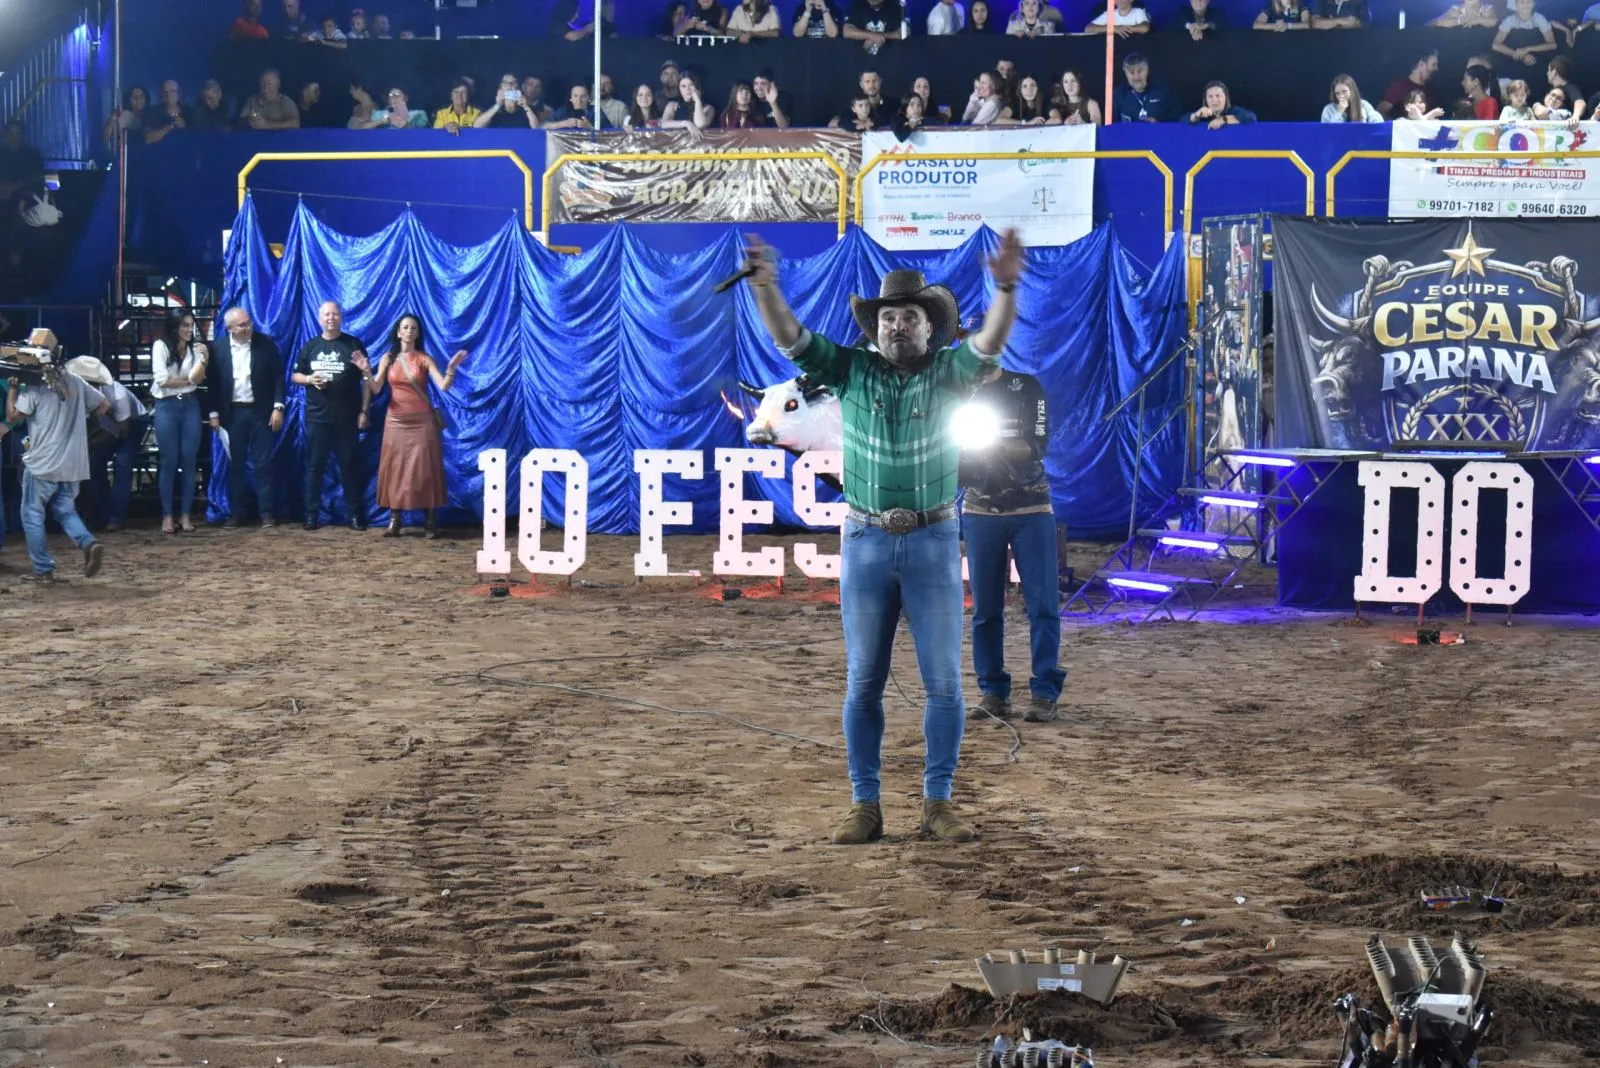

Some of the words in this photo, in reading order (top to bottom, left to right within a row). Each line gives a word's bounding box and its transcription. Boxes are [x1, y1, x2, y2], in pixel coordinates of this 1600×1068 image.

[878, 170, 978, 184] PRODUTOR
[1449, 167, 1479, 175] TINTAS
[1481, 168, 1520, 176] PREDIAIS
[1529, 170, 1584, 179] INDUSTRIAIS
[1447, 178, 1496, 191] Sempre
[1512, 182, 1545, 191] para
[1429, 200, 1494, 212] 99701-7182
[1521, 203, 1587, 215] 99640-6320
[947, 212, 982, 221] Branco
[1428, 284, 1509, 297] EQUIPE
[1374, 296, 1560, 351] CÉSAR
[1424, 413, 1502, 441] XXX
[1354, 460, 1534, 605] DO
